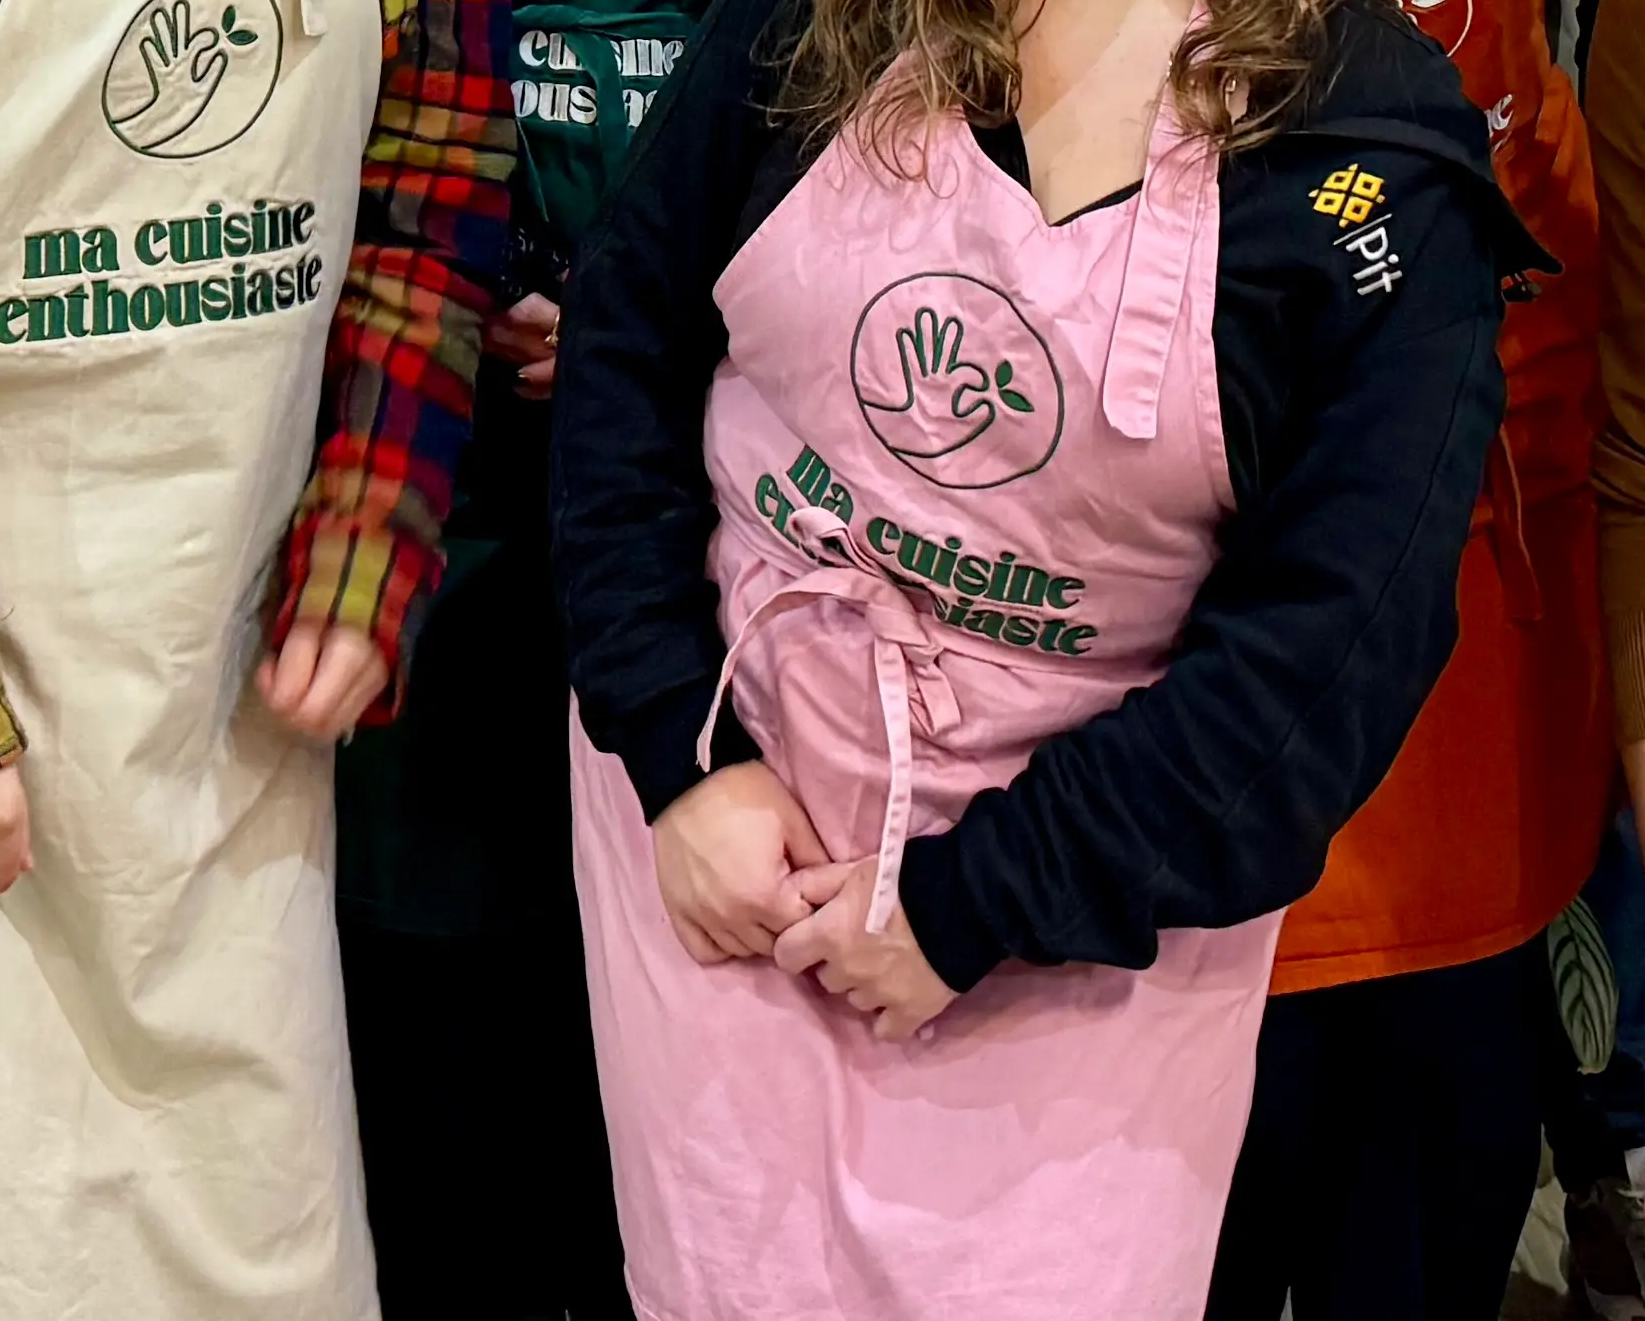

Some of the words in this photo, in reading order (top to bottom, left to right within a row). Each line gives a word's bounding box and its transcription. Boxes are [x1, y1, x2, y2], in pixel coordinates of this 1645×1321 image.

[23, 225, 120, 280] ma
[135, 200, 315, 266] cuisine
[785, 444, 854, 526] ma
[866, 517, 1086, 609] cuisine
